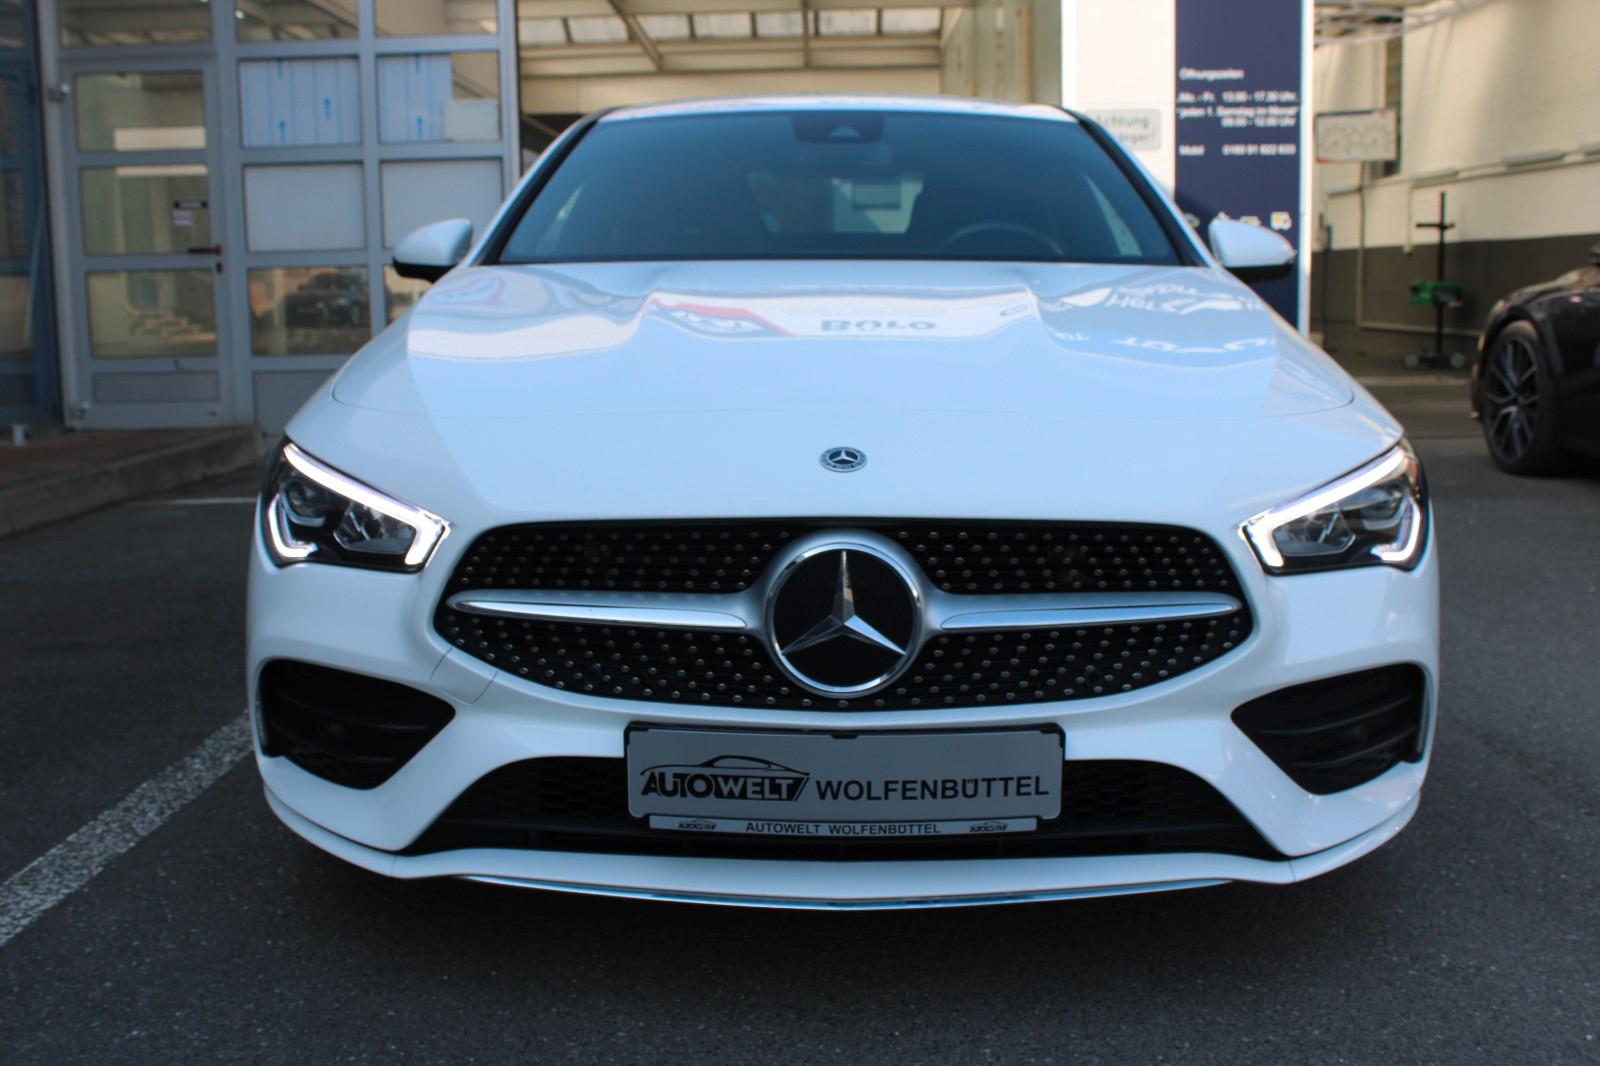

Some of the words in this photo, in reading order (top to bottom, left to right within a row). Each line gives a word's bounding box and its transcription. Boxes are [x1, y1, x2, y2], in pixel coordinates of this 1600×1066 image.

[641, 770, 795, 801] AUTOWELT
[816, 775, 1049, 801] WOLFENBÜTTEL
[745, 822, 821, 834] AUTOWELT
[828, 822, 941, 835] WOLFENBÜTTEL
